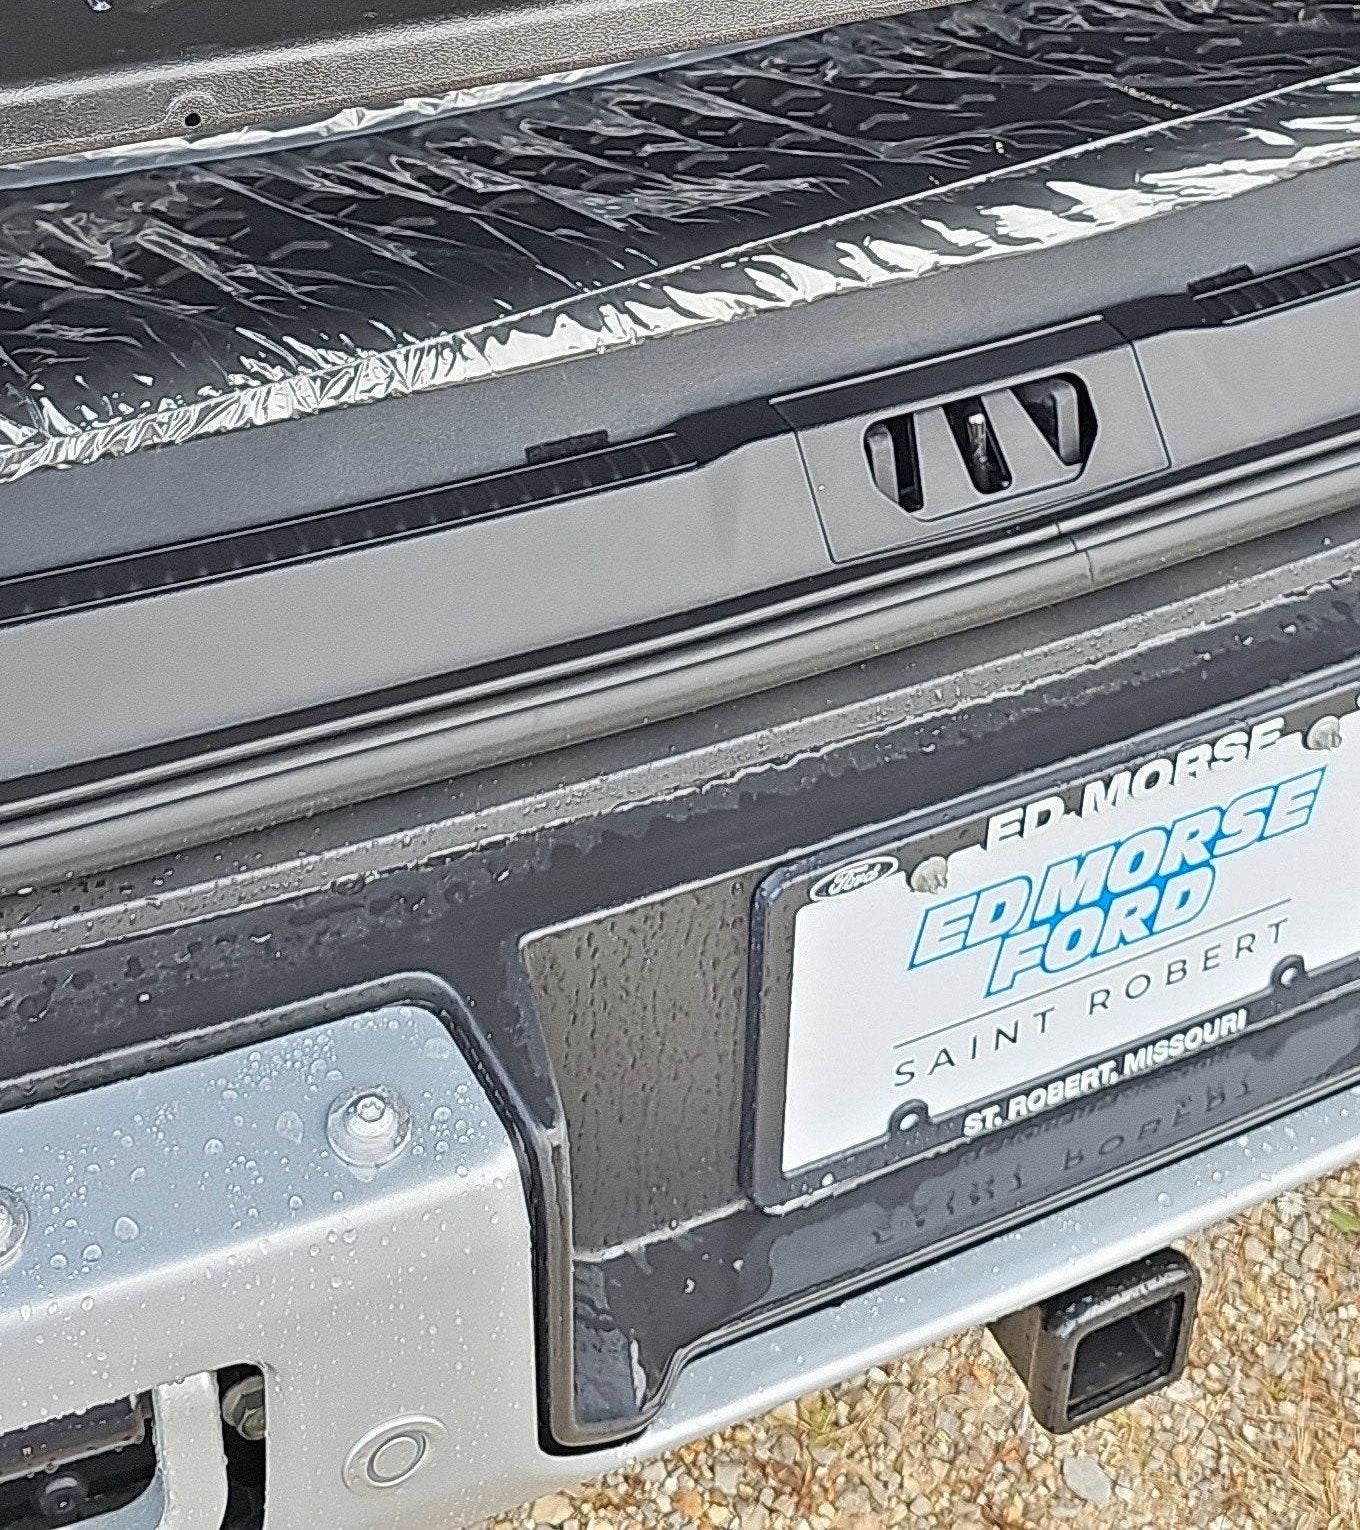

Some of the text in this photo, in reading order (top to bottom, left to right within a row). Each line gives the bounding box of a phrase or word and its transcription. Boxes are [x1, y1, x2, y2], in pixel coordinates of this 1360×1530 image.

[985, 716, 1286, 852] ED MORSE
[906, 764, 1327, 970] ED MORSE
[982, 863, 1218, 999] FORD
[893, 918, 1289, 1088] SAINT ROBERT
[962, 1103, 1004, 1137] ST.
[1006, 1063, 1119, 1122] ROBERT,
[1123, 1008, 1248, 1076] MISSOURI
